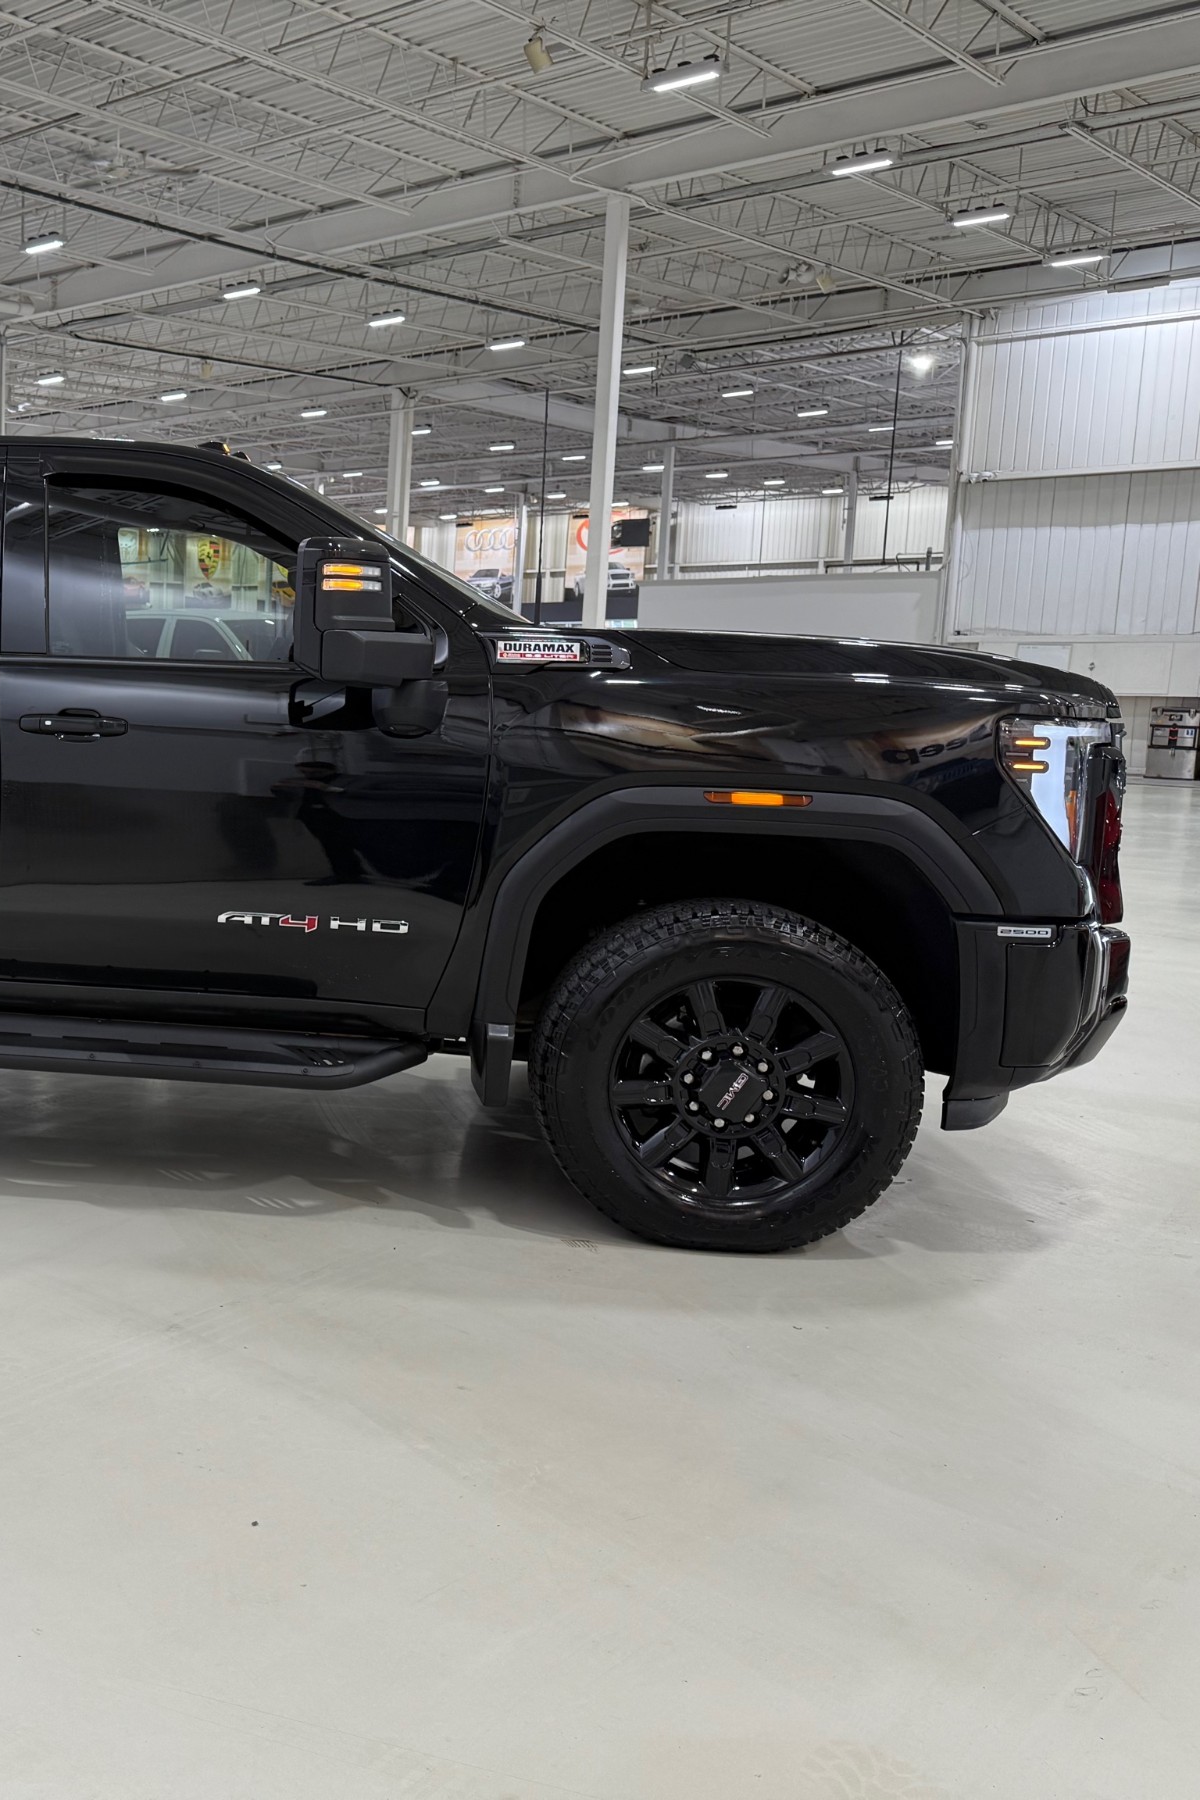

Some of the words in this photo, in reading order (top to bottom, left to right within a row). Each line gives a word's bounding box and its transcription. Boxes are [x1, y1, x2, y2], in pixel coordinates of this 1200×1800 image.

[503, 643, 574, 653] DURAMAX
[217, 911, 319, 932] AT4
[330, 916, 409, 933] HD
[716, 1072, 749, 1111] GMC
